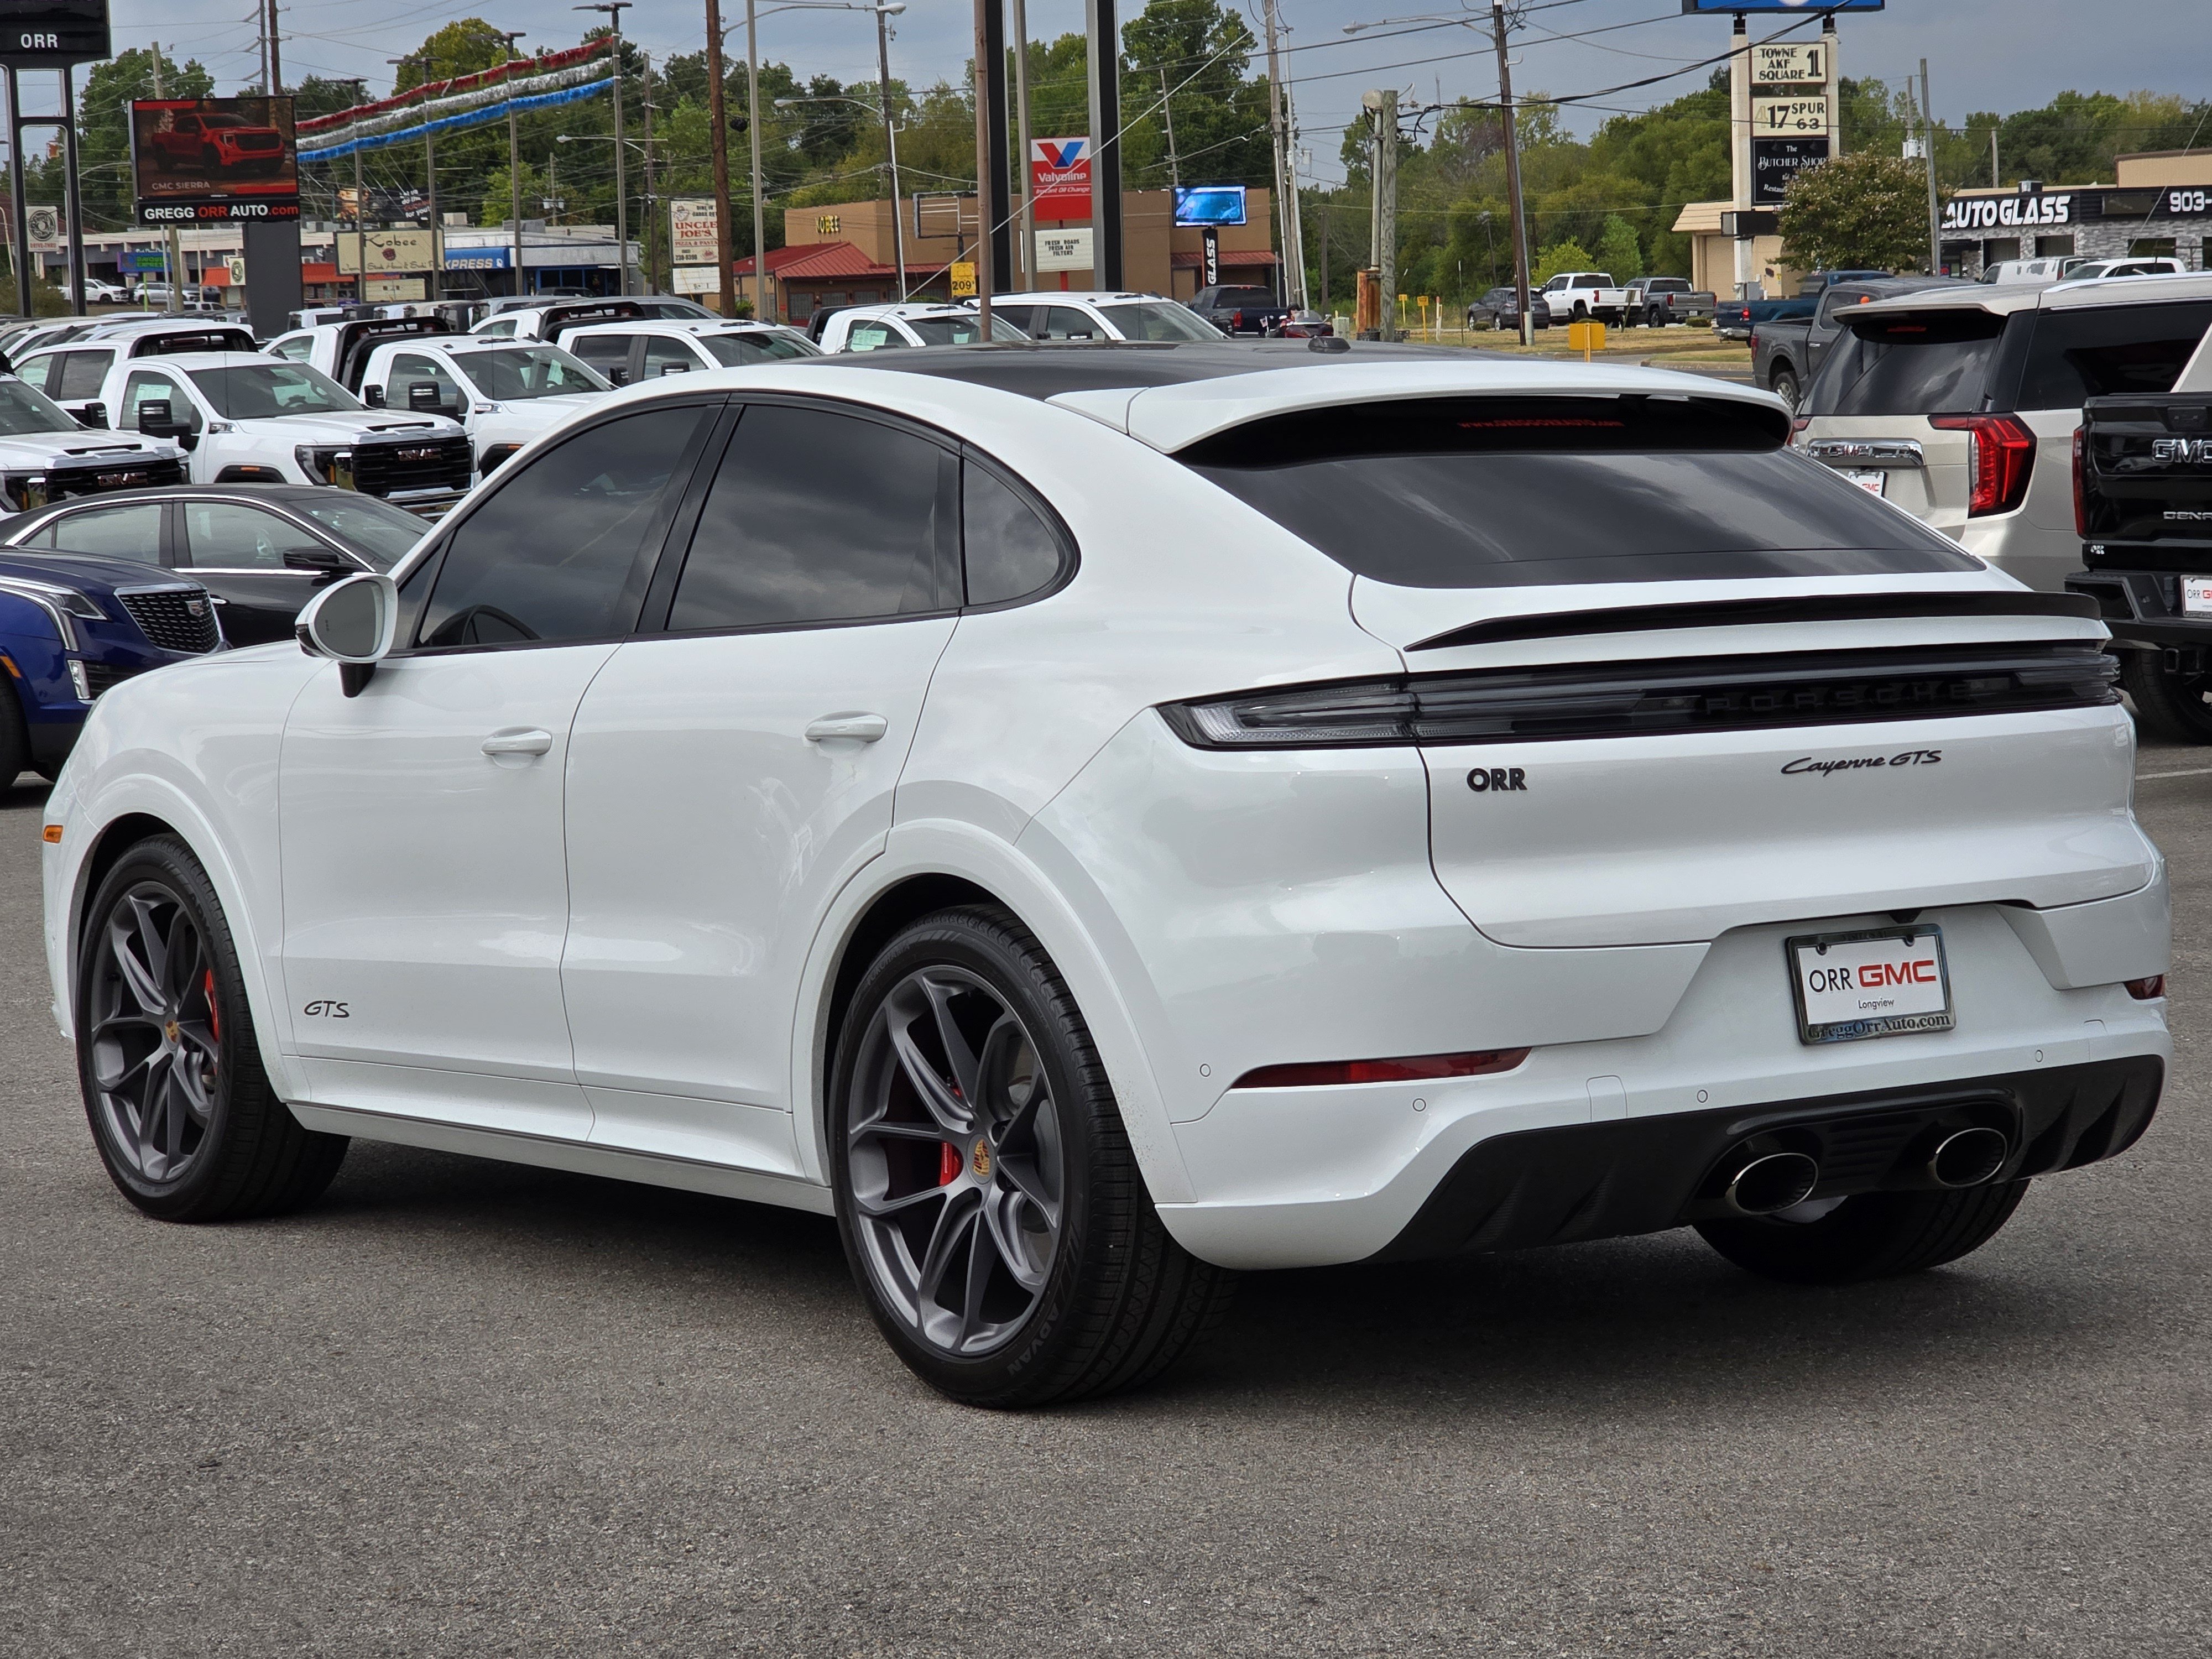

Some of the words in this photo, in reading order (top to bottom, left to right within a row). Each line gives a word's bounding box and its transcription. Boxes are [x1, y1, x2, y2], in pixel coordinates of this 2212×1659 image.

[20, 34, 58, 49] ORR
[1759, 48, 1797, 58] TOWNE
[1767, 59, 1790, 69] AKF
[1759, 70, 1805, 80] SQUARE
[1792, 102, 1825, 114] SPUR
[1767, 105, 1791, 128] 17
[1797, 118, 1820, 130] 63
[1037, 172, 1087, 182] Valvoline
[176, 181, 210, 189] SIERRA
[144, 207, 195, 220] GREGG
[198, 206, 228, 218] ORR
[675, 221, 718, 230] UNCLE
[680, 229, 711, 239] JOE'S
[1206, 238, 1217, 285] GLASS
[398, 447, 443, 462] GMC
[97, 472, 149, 487] GMC
[2187, 589, 2201, 599] ORR
[1781, 757, 1886, 777] Cayenne
[1889, 750, 1942, 765] GTS
[1467, 768, 1528, 792] ORR
[1809, 967, 1854, 993] ORR
[1858, 959, 1937, 988] GMC
[304, 1000, 350, 1018] GTS
[1858, 998, 1895, 1011] Longview
[1807, 1014, 1951, 1039] GreggOrrAuto.com
[1006, 1302, 1060, 1378] ADVAN
